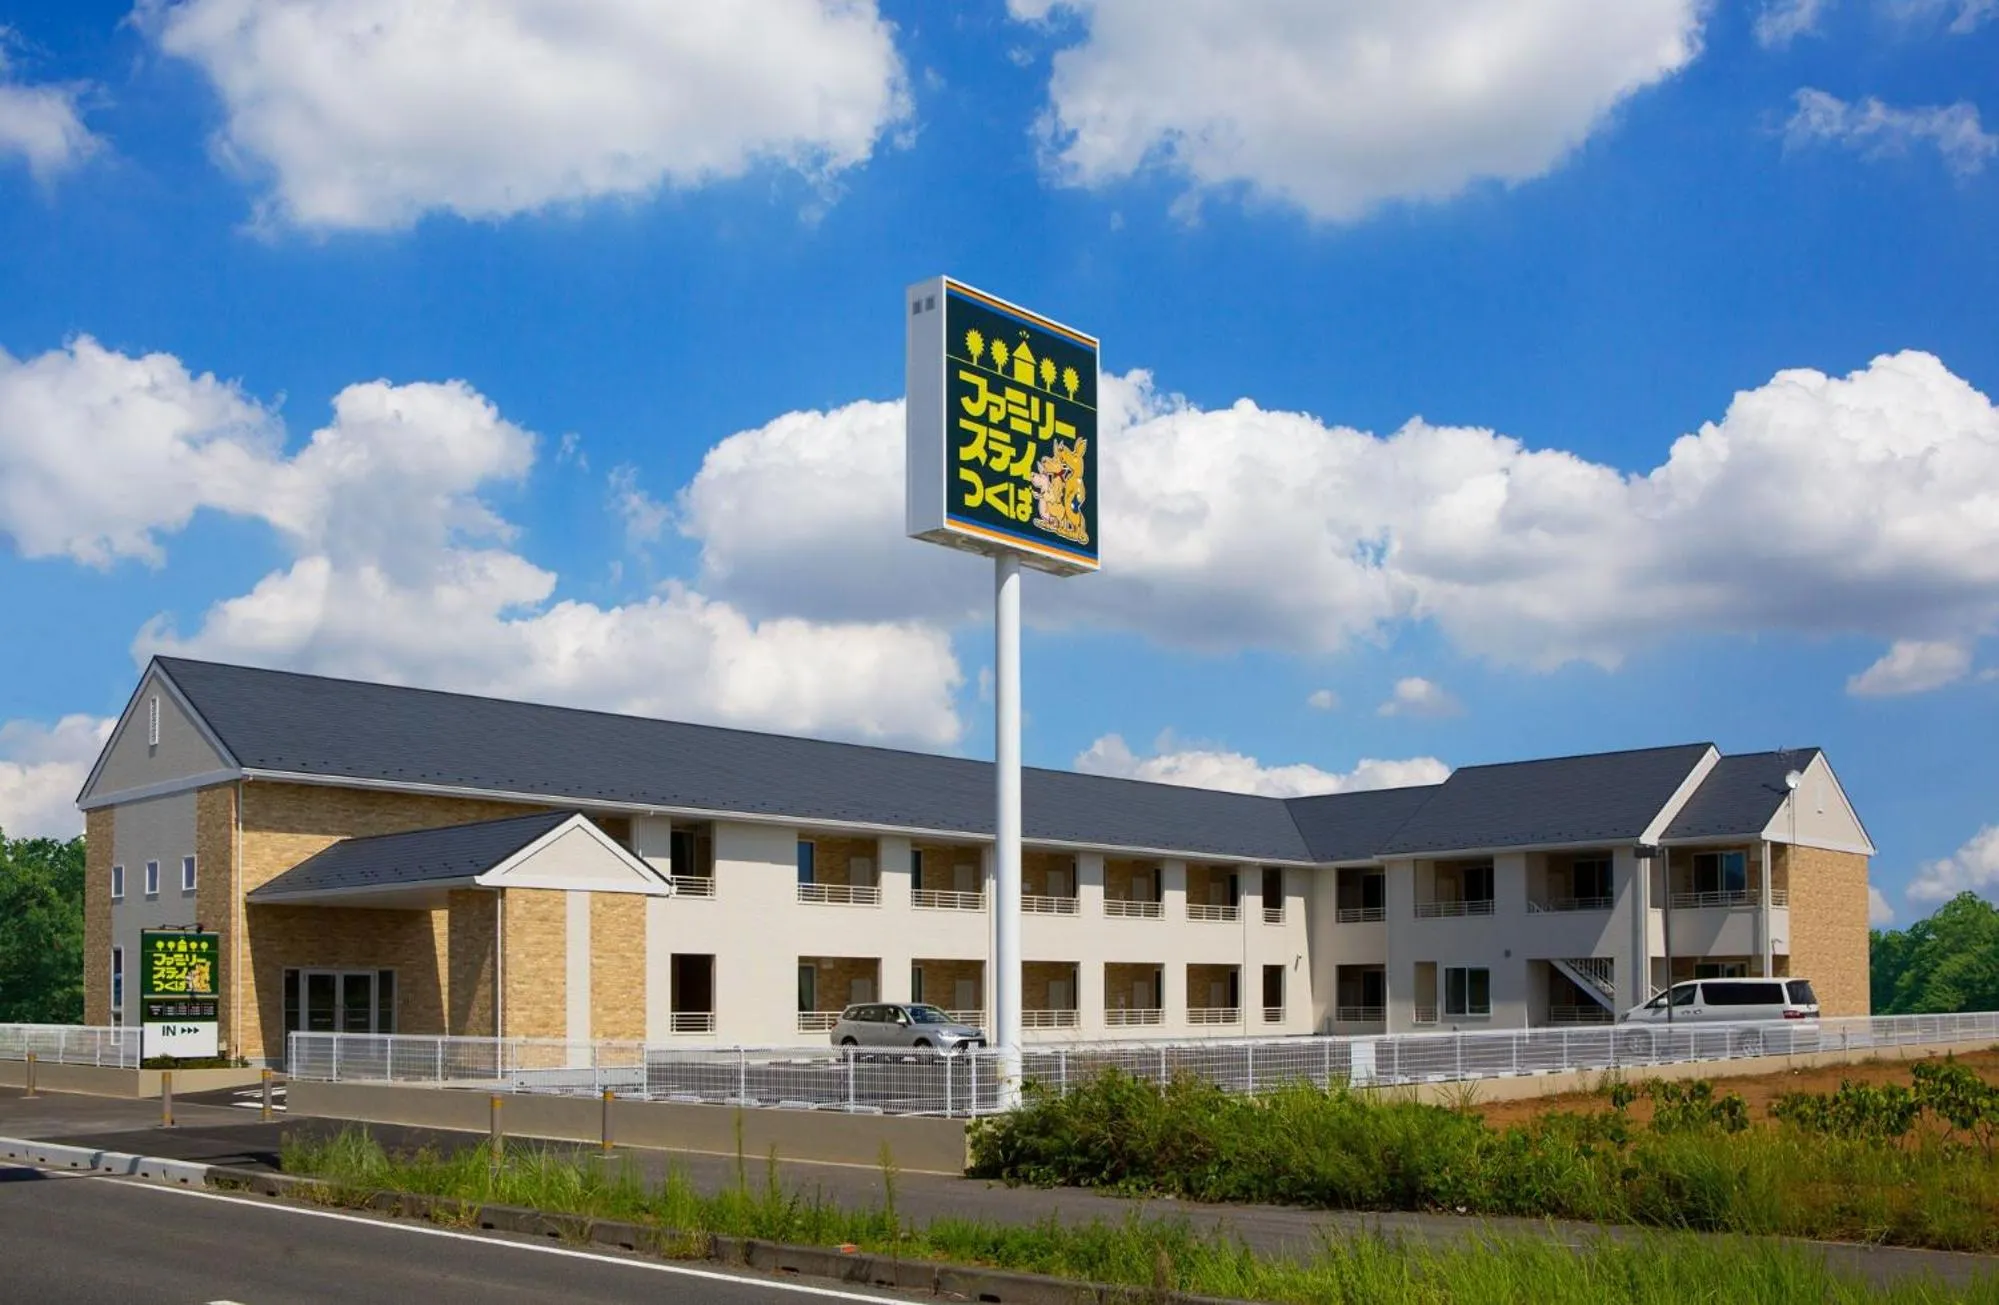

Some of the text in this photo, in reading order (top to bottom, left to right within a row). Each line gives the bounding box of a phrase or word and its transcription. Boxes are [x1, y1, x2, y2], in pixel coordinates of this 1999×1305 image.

[959, 369, 1076, 441] ファミリー
[959, 467, 1033, 522] つくば
[162, 1025, 176, 1036] IN
